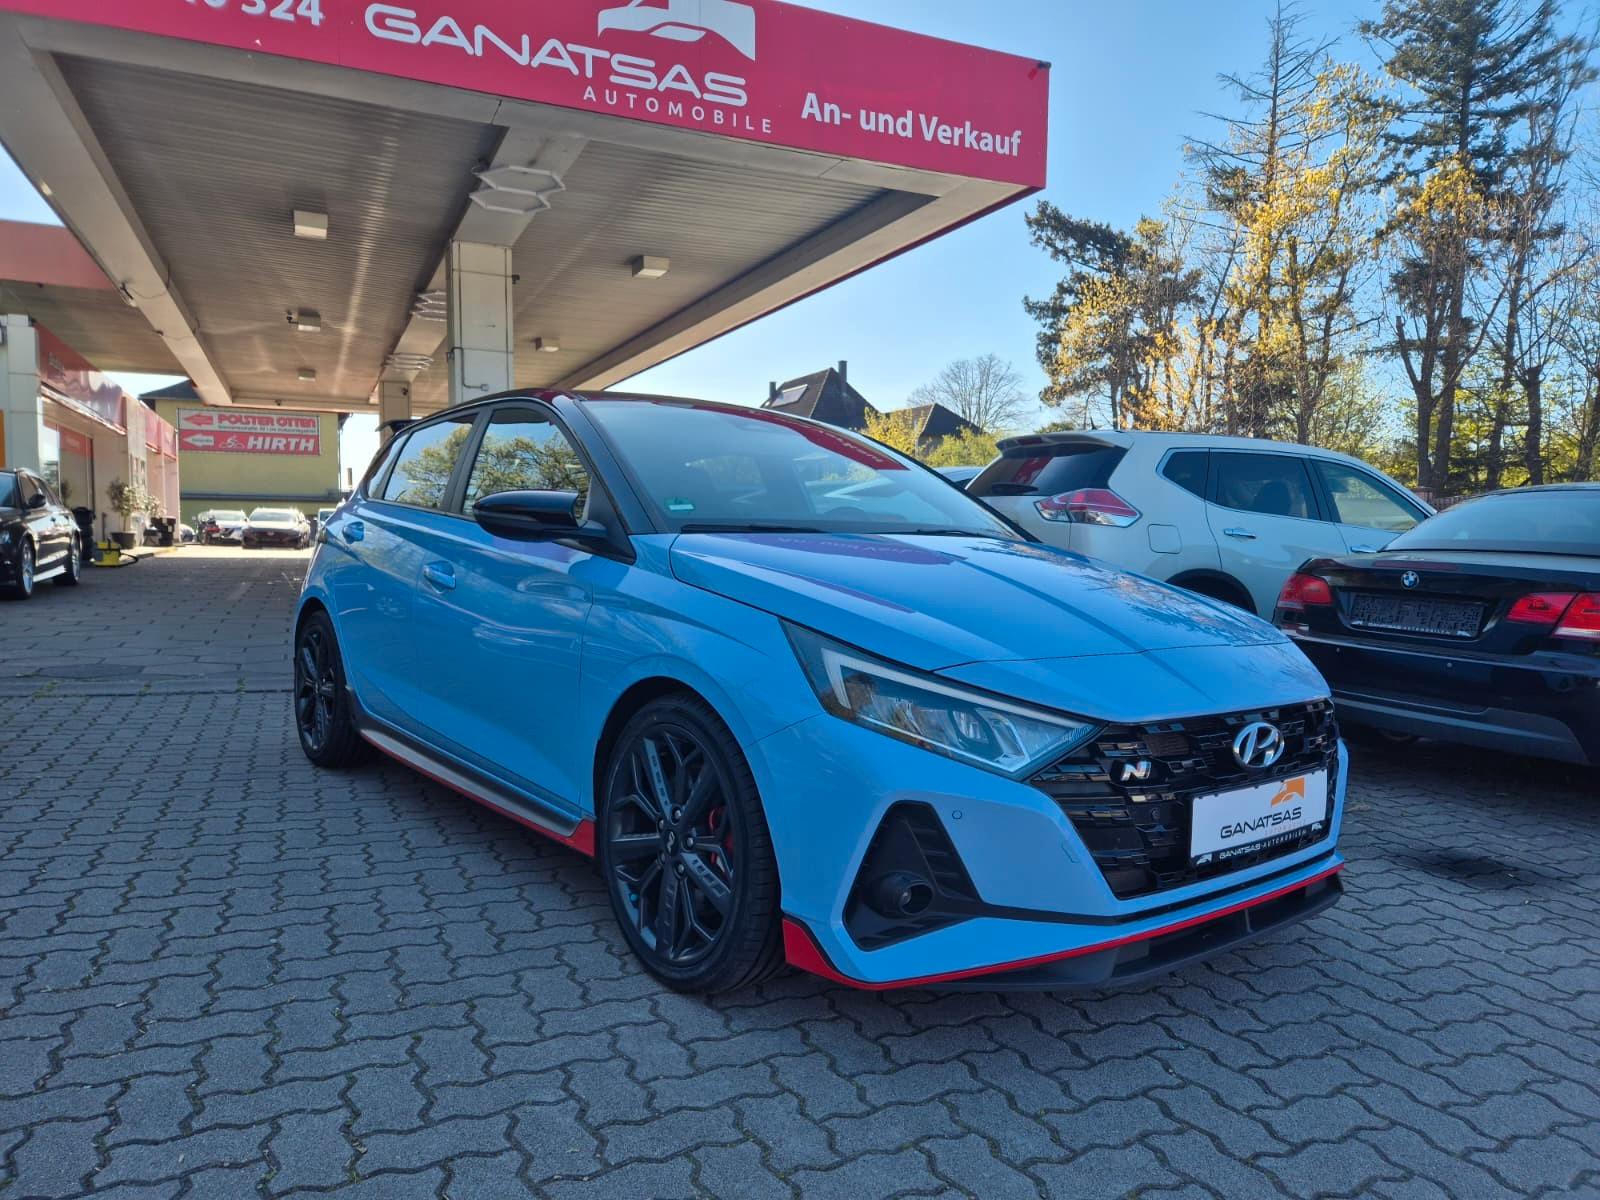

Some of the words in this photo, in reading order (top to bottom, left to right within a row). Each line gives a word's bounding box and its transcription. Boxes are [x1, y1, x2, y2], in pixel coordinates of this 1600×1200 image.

[365, 3, 747, 107] GANATSAS
[583, 86, 772, 133] AUTOMOBILE
[801, 92, 852, 125] An-
[860, 109, 913, 138] und
[919, 113, 1022, 157] Verkauf
[217, 414, 275, 426] POLSTER
[247, 435, 315, 451] HIRTH
[1121, 760, 1152, 781] N
[1220, 807, 1302, 839] GANATSAS
